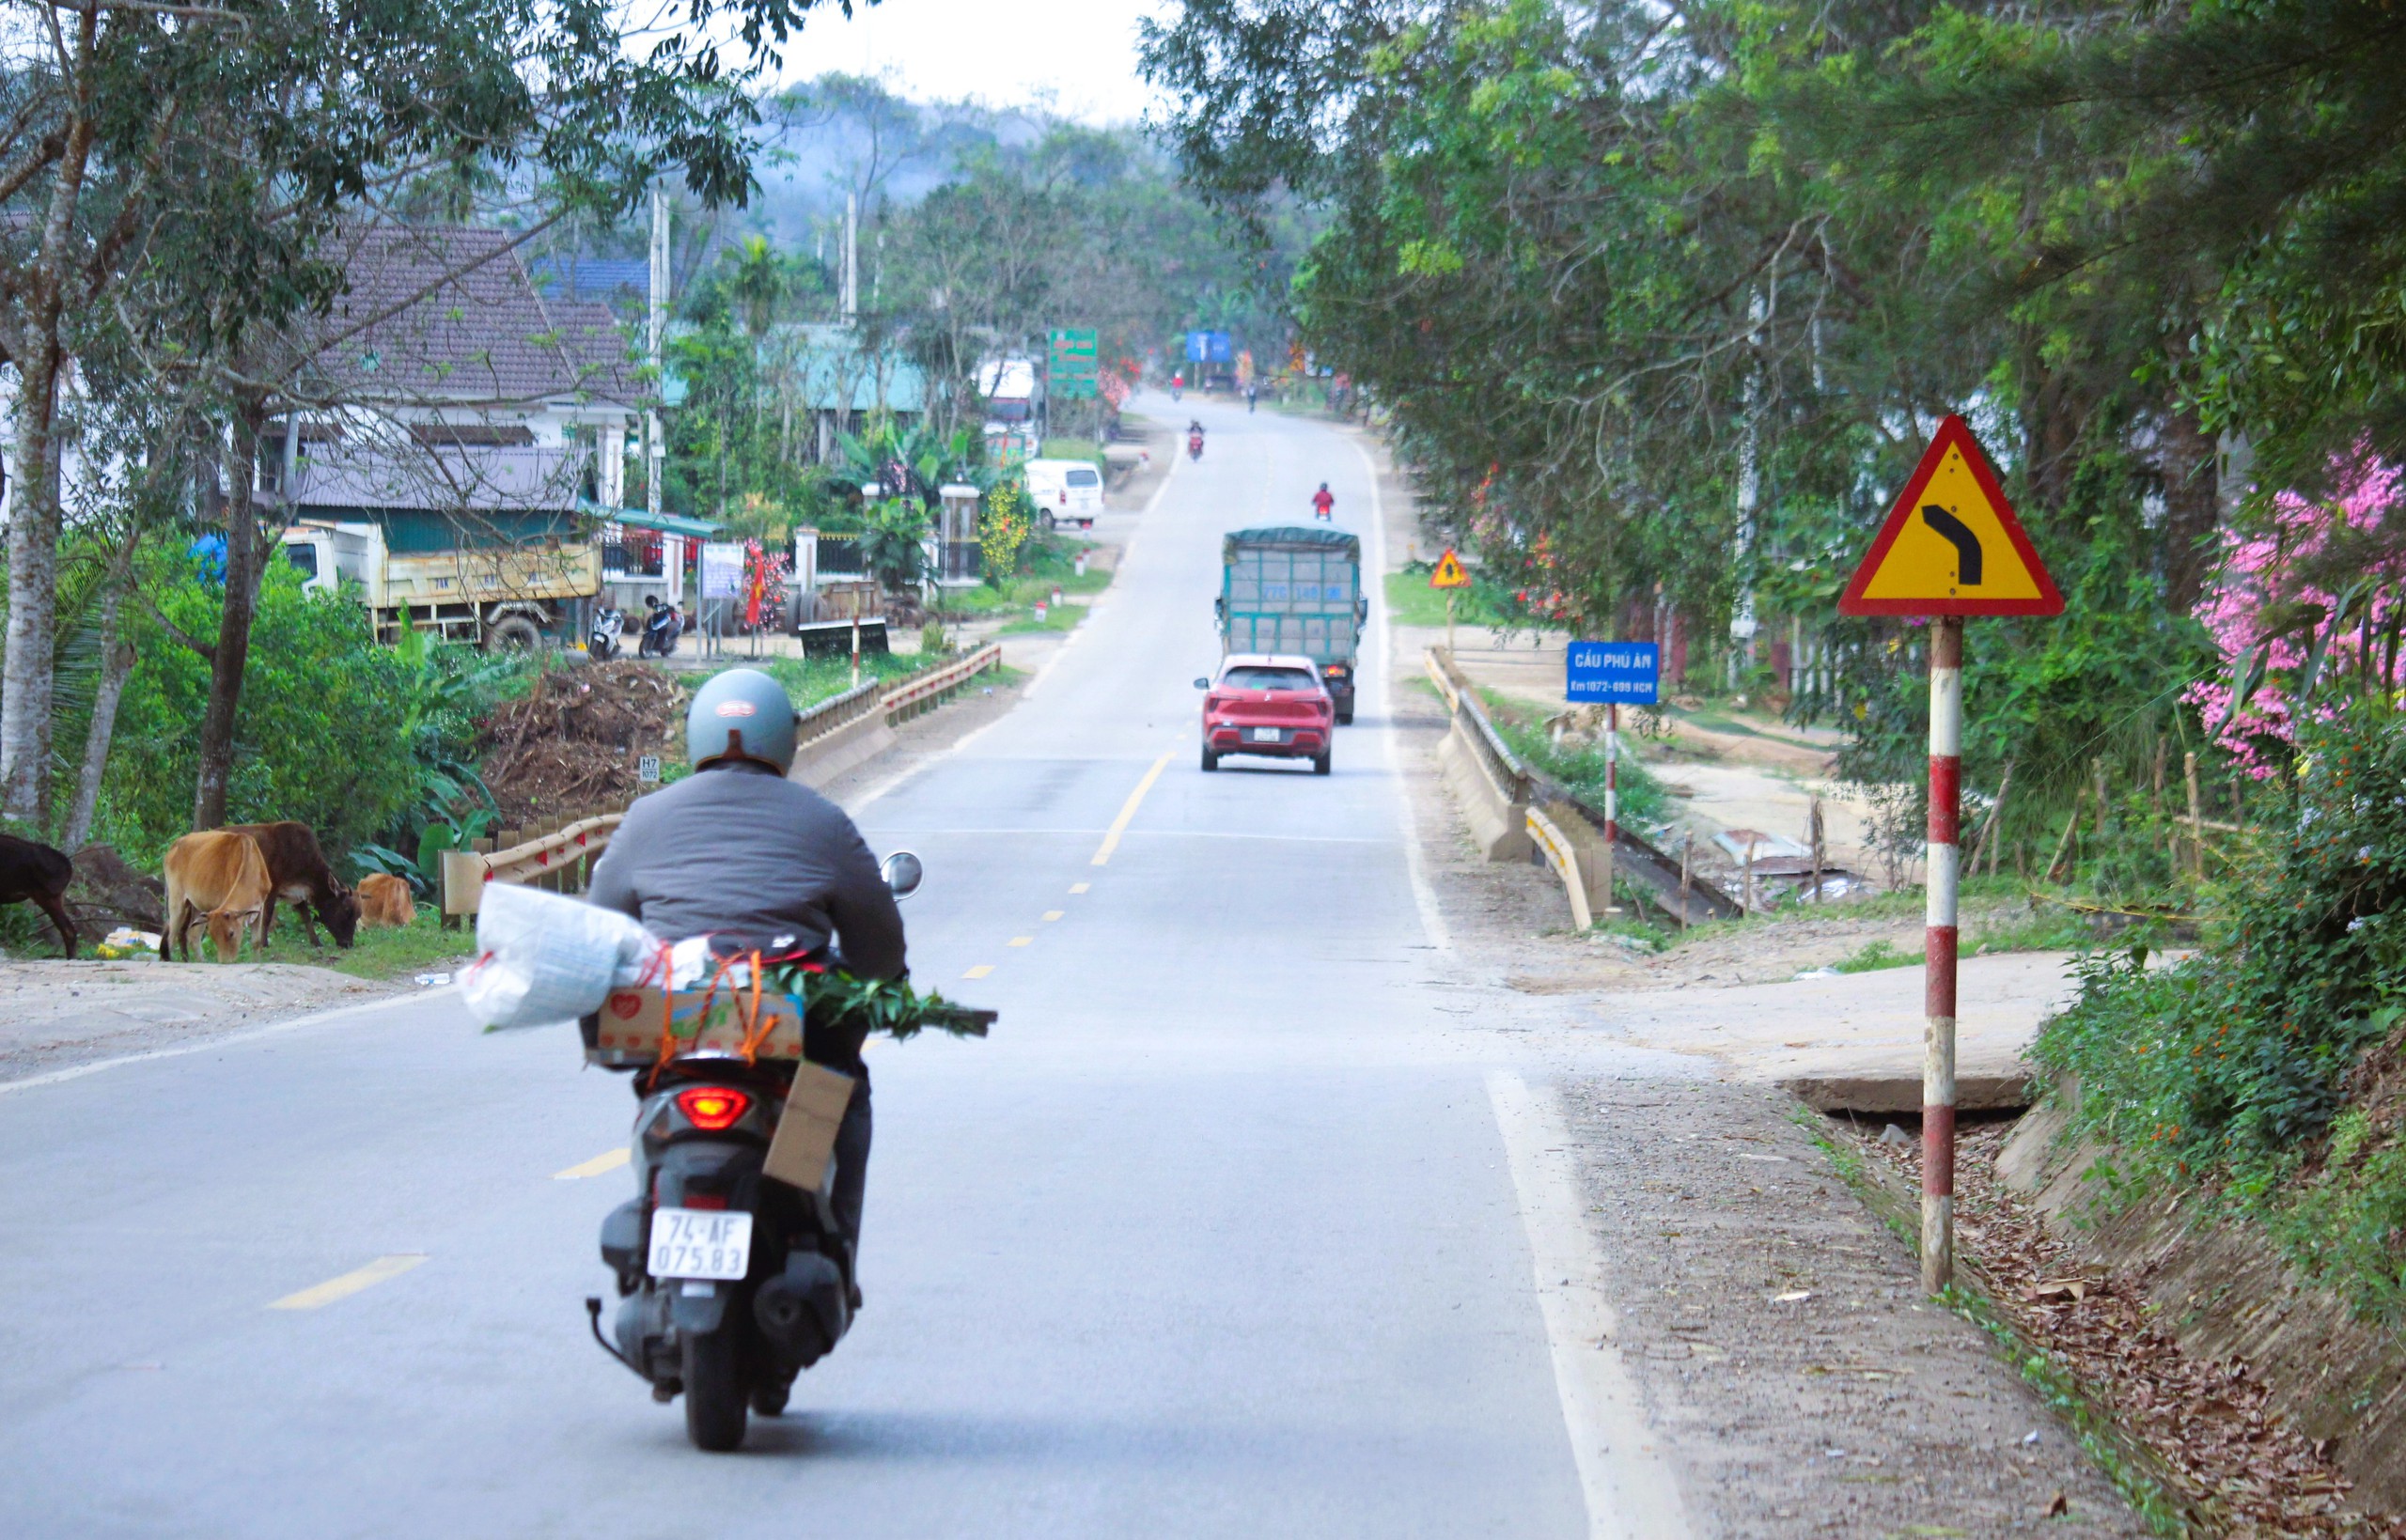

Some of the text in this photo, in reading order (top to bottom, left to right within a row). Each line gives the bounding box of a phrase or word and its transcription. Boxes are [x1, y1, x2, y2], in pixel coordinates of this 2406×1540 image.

[1603, 651, 1631, 669] PHÚ
[642, 758, 657, 769] H7
[642, 770, 658, 779] 1072
